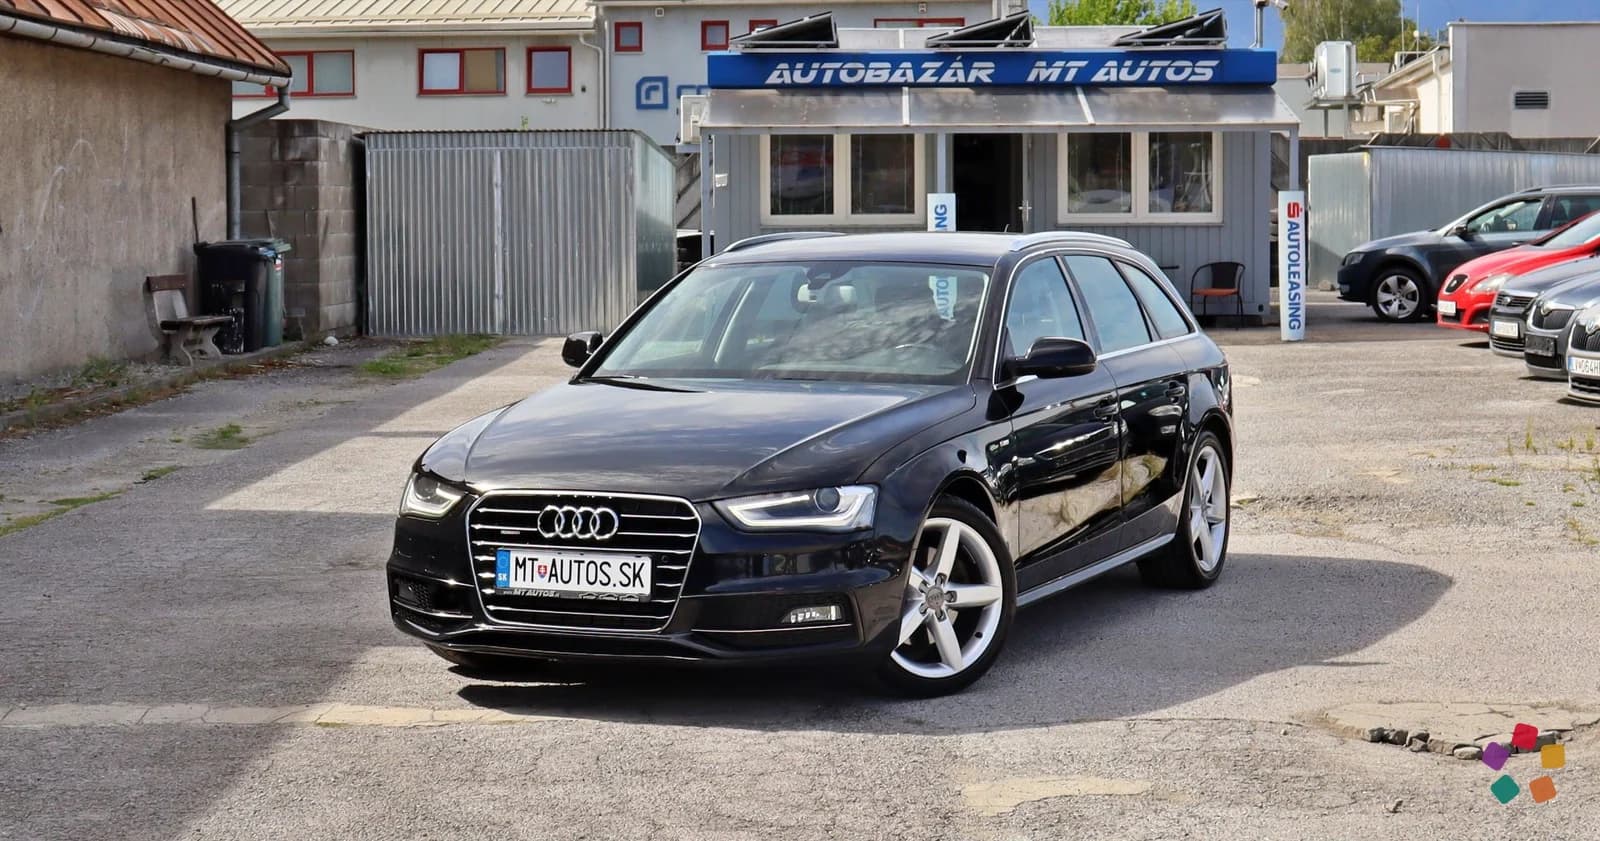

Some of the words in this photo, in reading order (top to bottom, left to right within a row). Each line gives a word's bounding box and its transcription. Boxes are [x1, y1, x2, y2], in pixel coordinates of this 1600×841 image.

[765, 55, 996, 84] AUTOBAZÁR
[1026, 60, 1089, 82] MT
[1090, 60, 1220, 82] AUTOS
[1287, 220, 1301, 330] AUTOLEASING
[497, 572, 508, 581] SK
[515, 557, 538, 582] MT
[548, 558, 645, 588] AUTOS.SK
